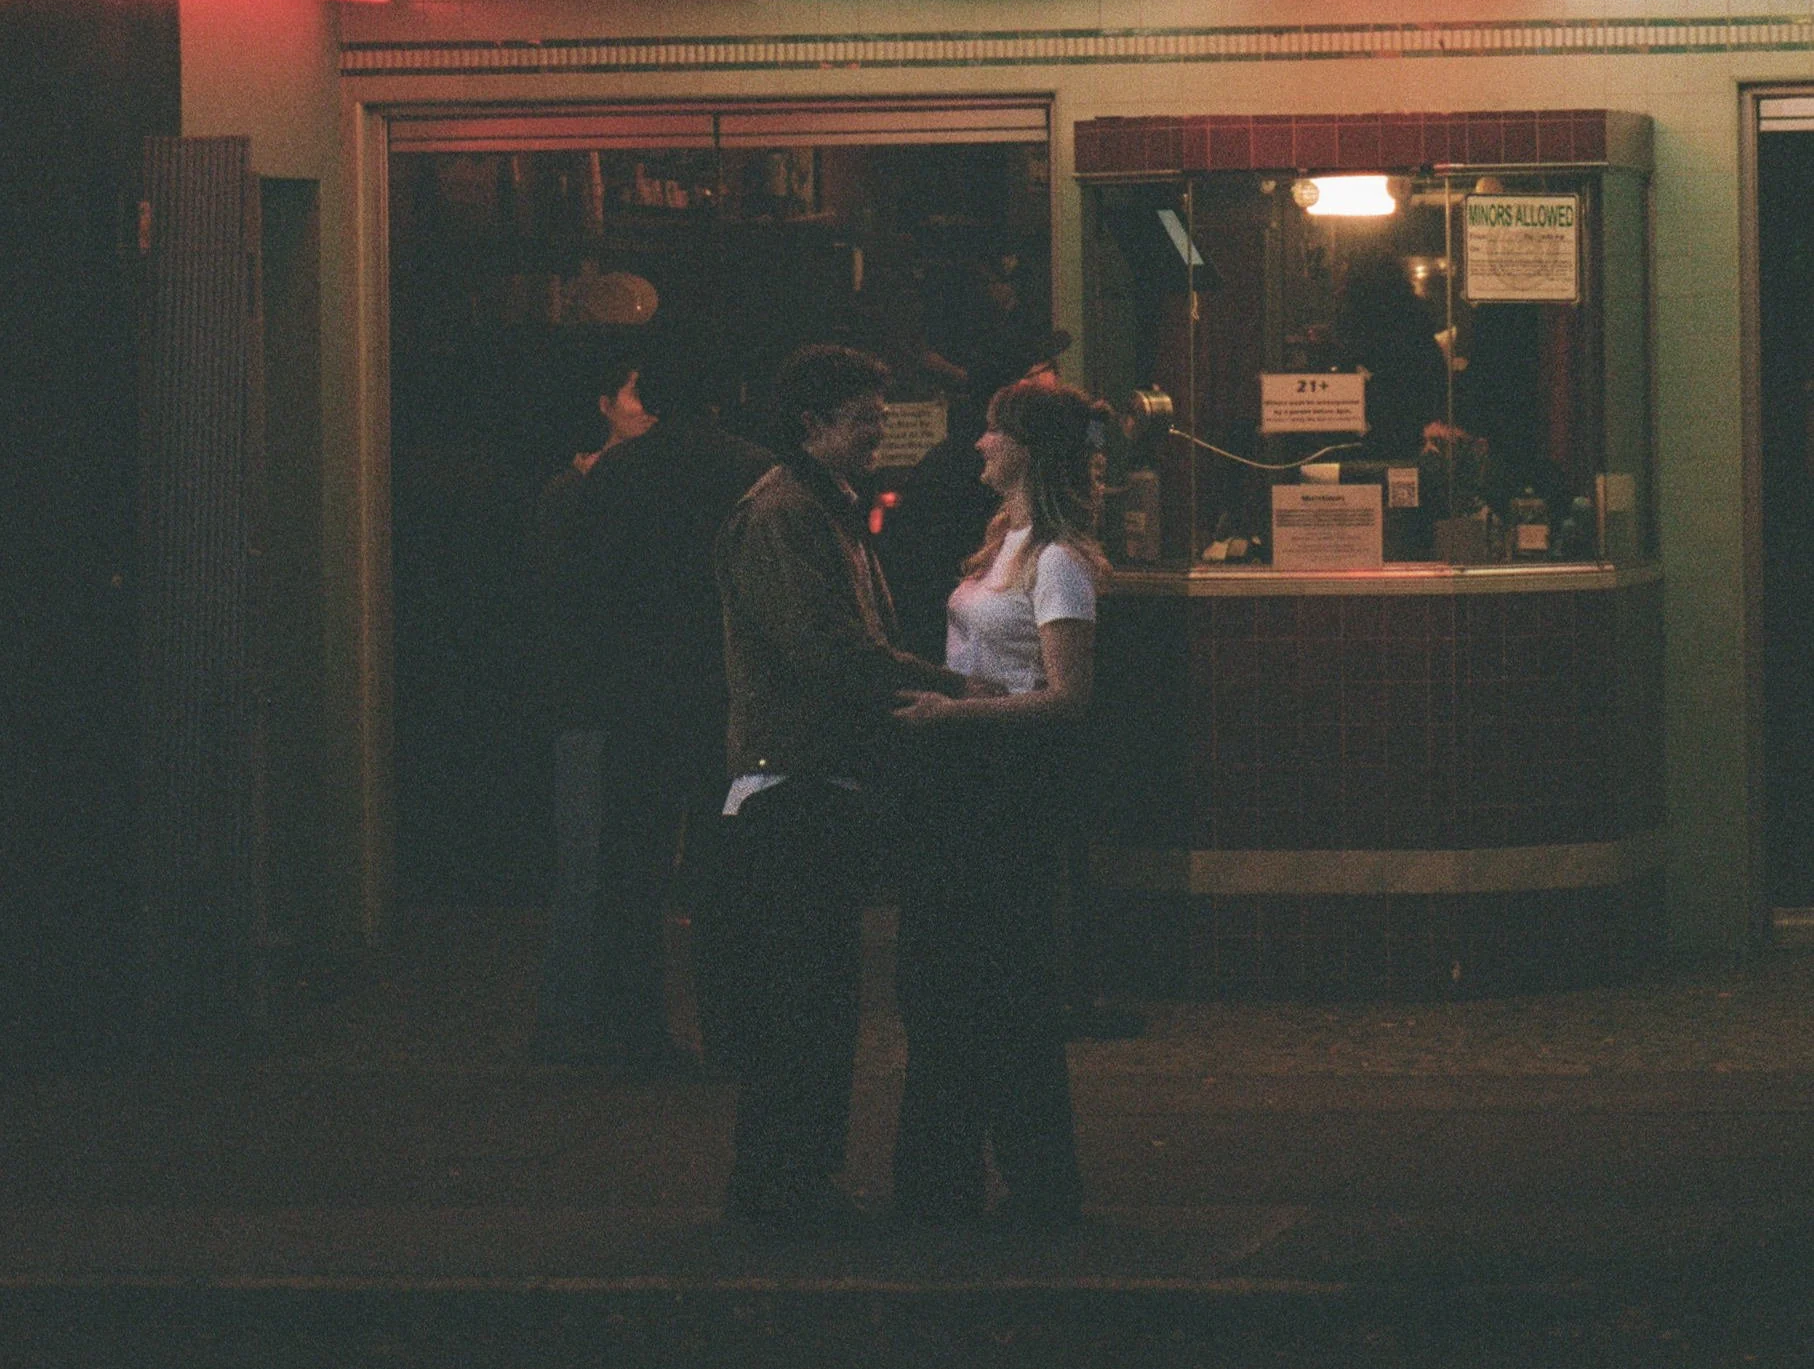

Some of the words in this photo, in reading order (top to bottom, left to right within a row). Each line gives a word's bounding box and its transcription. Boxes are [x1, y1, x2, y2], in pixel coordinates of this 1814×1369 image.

[1468, 203, 1512, 227] MINORS
[1514, 203, 1573, 227] ALLOWED
[1297, 380, 1329, 393] 21+
